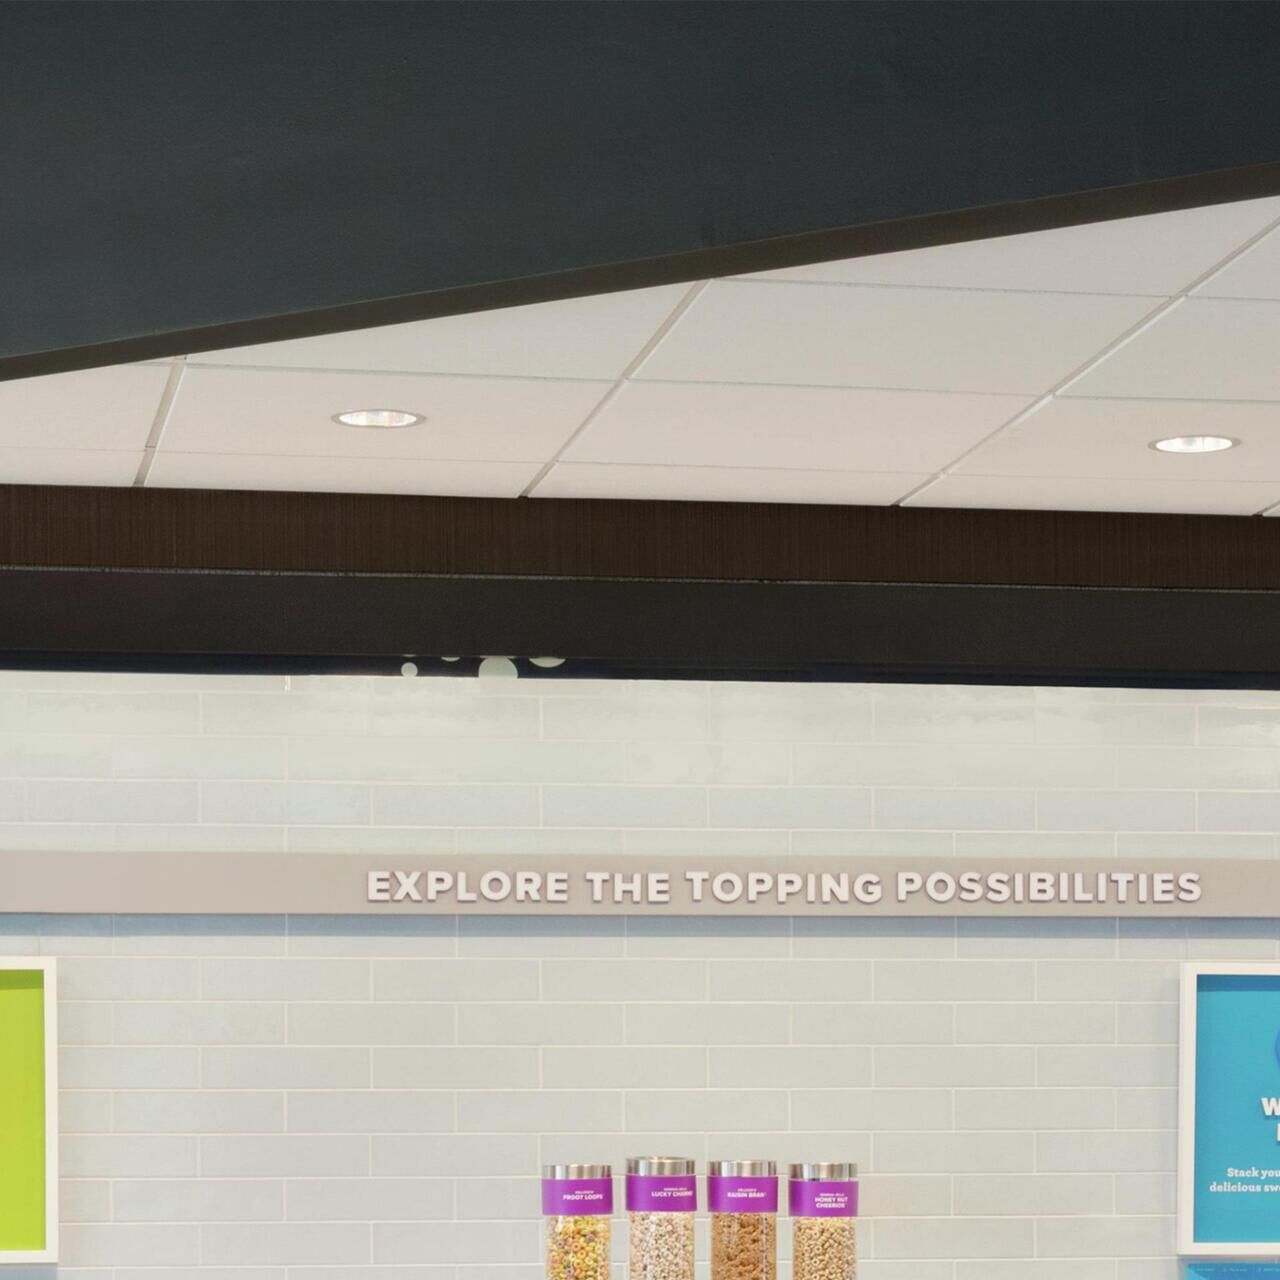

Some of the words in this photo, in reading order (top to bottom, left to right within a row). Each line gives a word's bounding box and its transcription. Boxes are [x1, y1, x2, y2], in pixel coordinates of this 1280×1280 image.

[367, 870, 569, 903] EXPLORE
[586, 872, 670, 903] THE
[685, 871, 882, 904] TOPPING
[896, 871, 1202, 903] POSSIBILITIES
[1227, 1167, 1259, 1179] Stack
[1209, 1181, 1262, 1193] delicious
